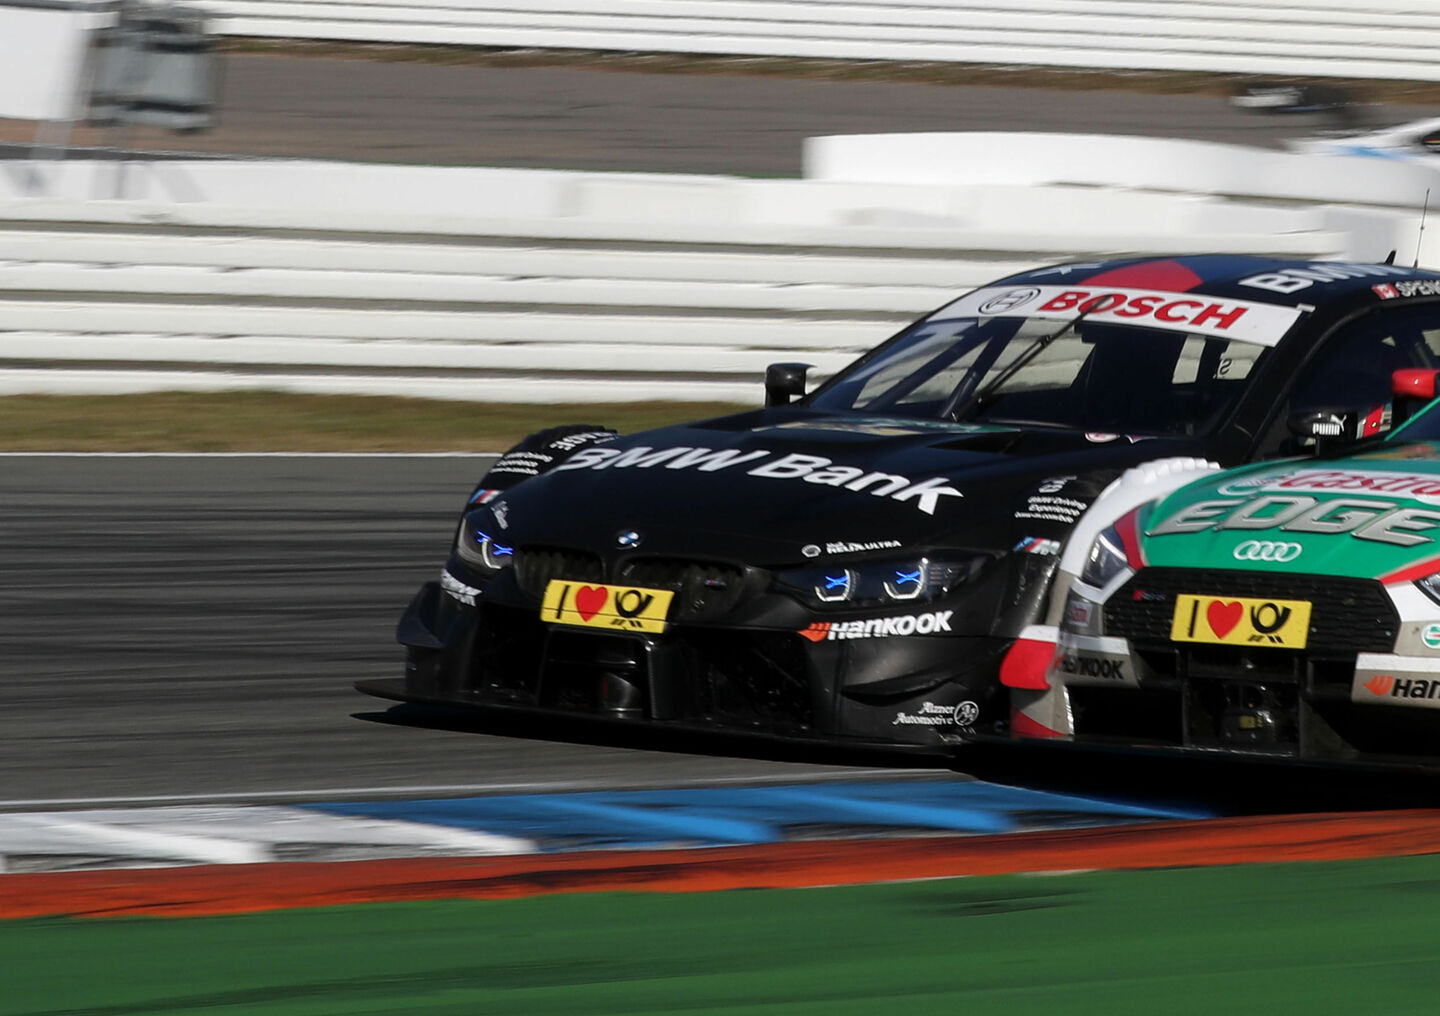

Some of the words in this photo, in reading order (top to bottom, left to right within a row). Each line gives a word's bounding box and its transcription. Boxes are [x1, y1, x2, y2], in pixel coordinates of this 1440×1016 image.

[1238, 263, 1410, 294] BMW
[1037, 291, 1250, 330] BOSCH
[543, 447, 770, 475] BMW
[747, 452, 964, 516] Bank
